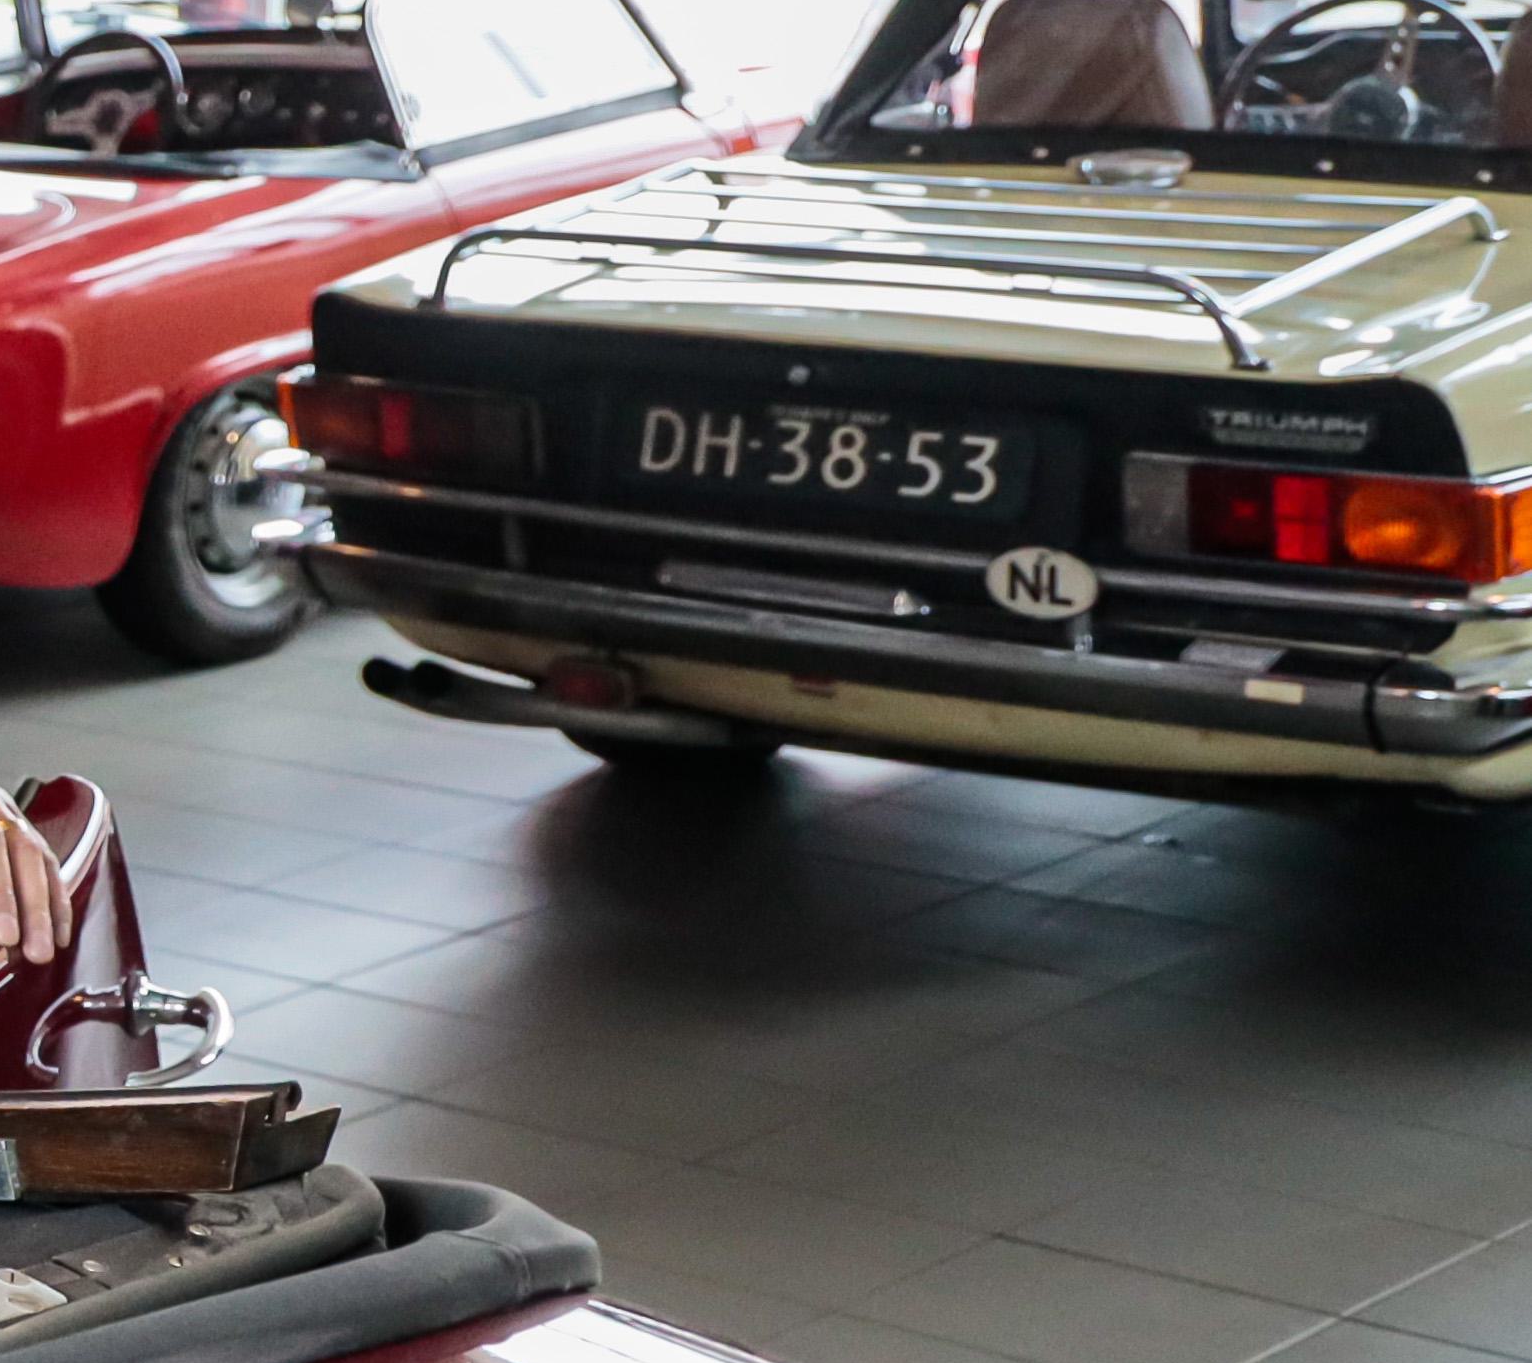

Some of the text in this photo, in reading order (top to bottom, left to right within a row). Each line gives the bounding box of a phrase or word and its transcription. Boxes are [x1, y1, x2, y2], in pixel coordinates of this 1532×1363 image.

[1209, 410, 1367, 436] TRIUMPH
[638, 406, 1000, 504] DH-38-53
[1008, 560, 1074, 607] NL
